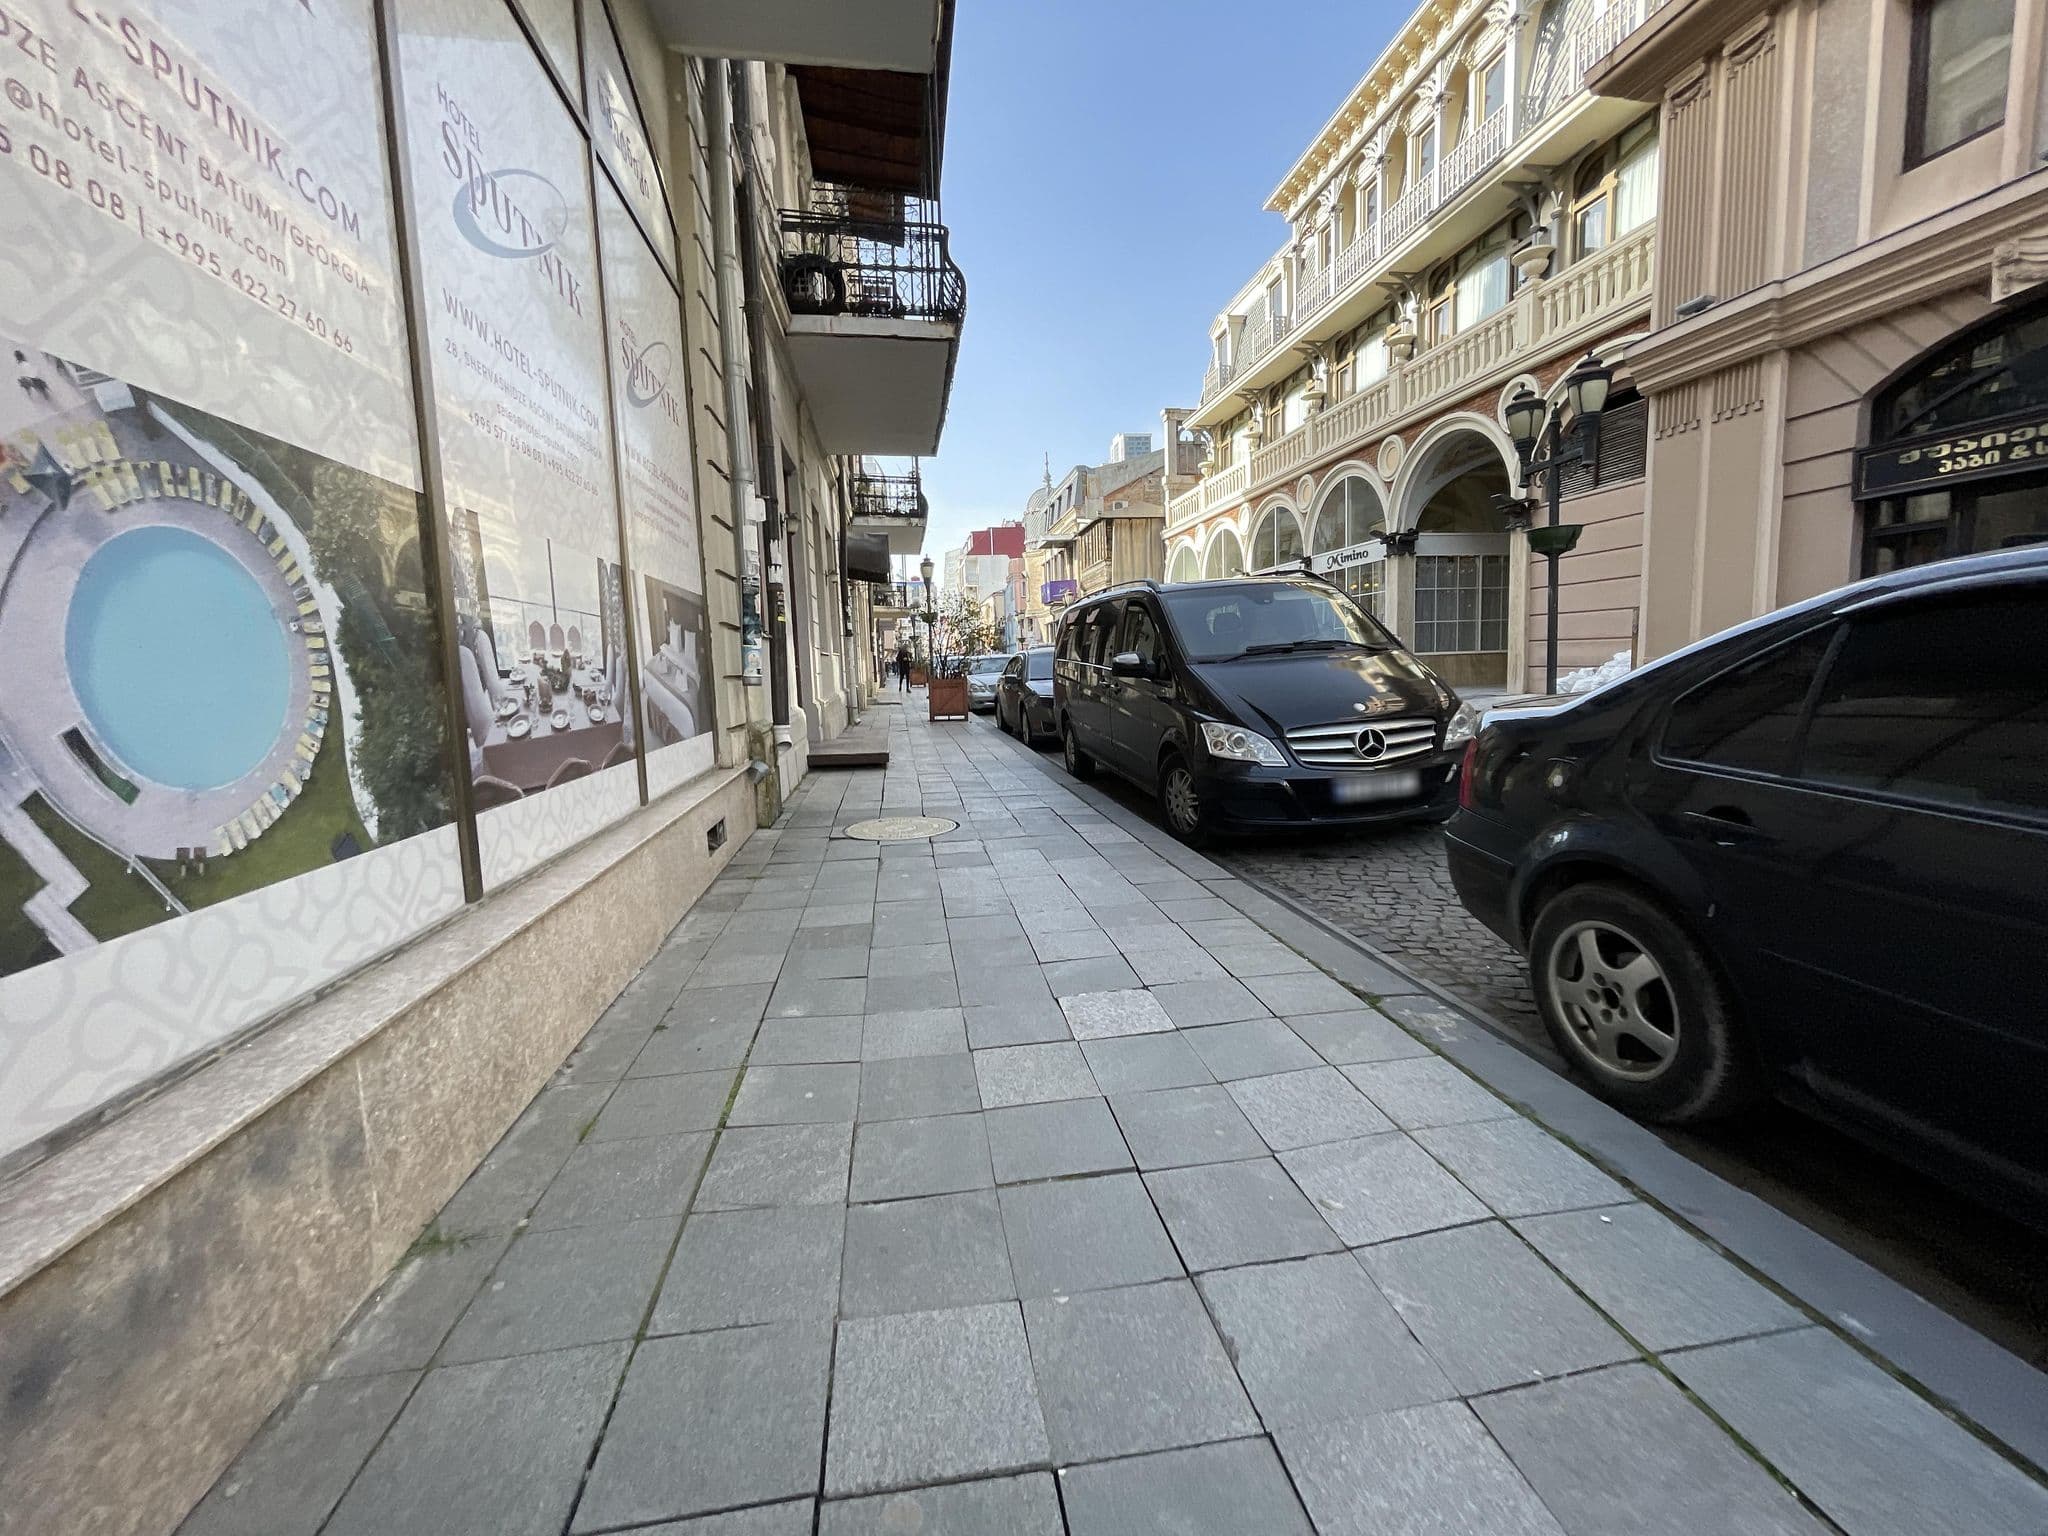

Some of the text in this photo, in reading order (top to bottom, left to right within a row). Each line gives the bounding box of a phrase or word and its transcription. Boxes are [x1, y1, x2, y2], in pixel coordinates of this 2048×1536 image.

[68, 0, 361, 241] -SPUTNIK.COM
[73, 66, 189, 165] ASCENT
[198, 155, 370, 297] BATUMI/GEORGIA
[437, 82, 483, 154] HOTEL
[29, 144, 73, 189] 08
[87, 179, 126, 221] 08
[157, 227, 221, 277] +995
[231, 267, 269, 305] 422
[276, 294, 297, 320] 27
[305, 311, 327, 338] 60
[333, 328, 353, 354] 66
[441, 119, 584, 319] SPUTNIK
[442, 287, 600, 433] WWW.HOTEL-SPUTNIK.COM
[1326, 550, 1369, 570] Mimino
